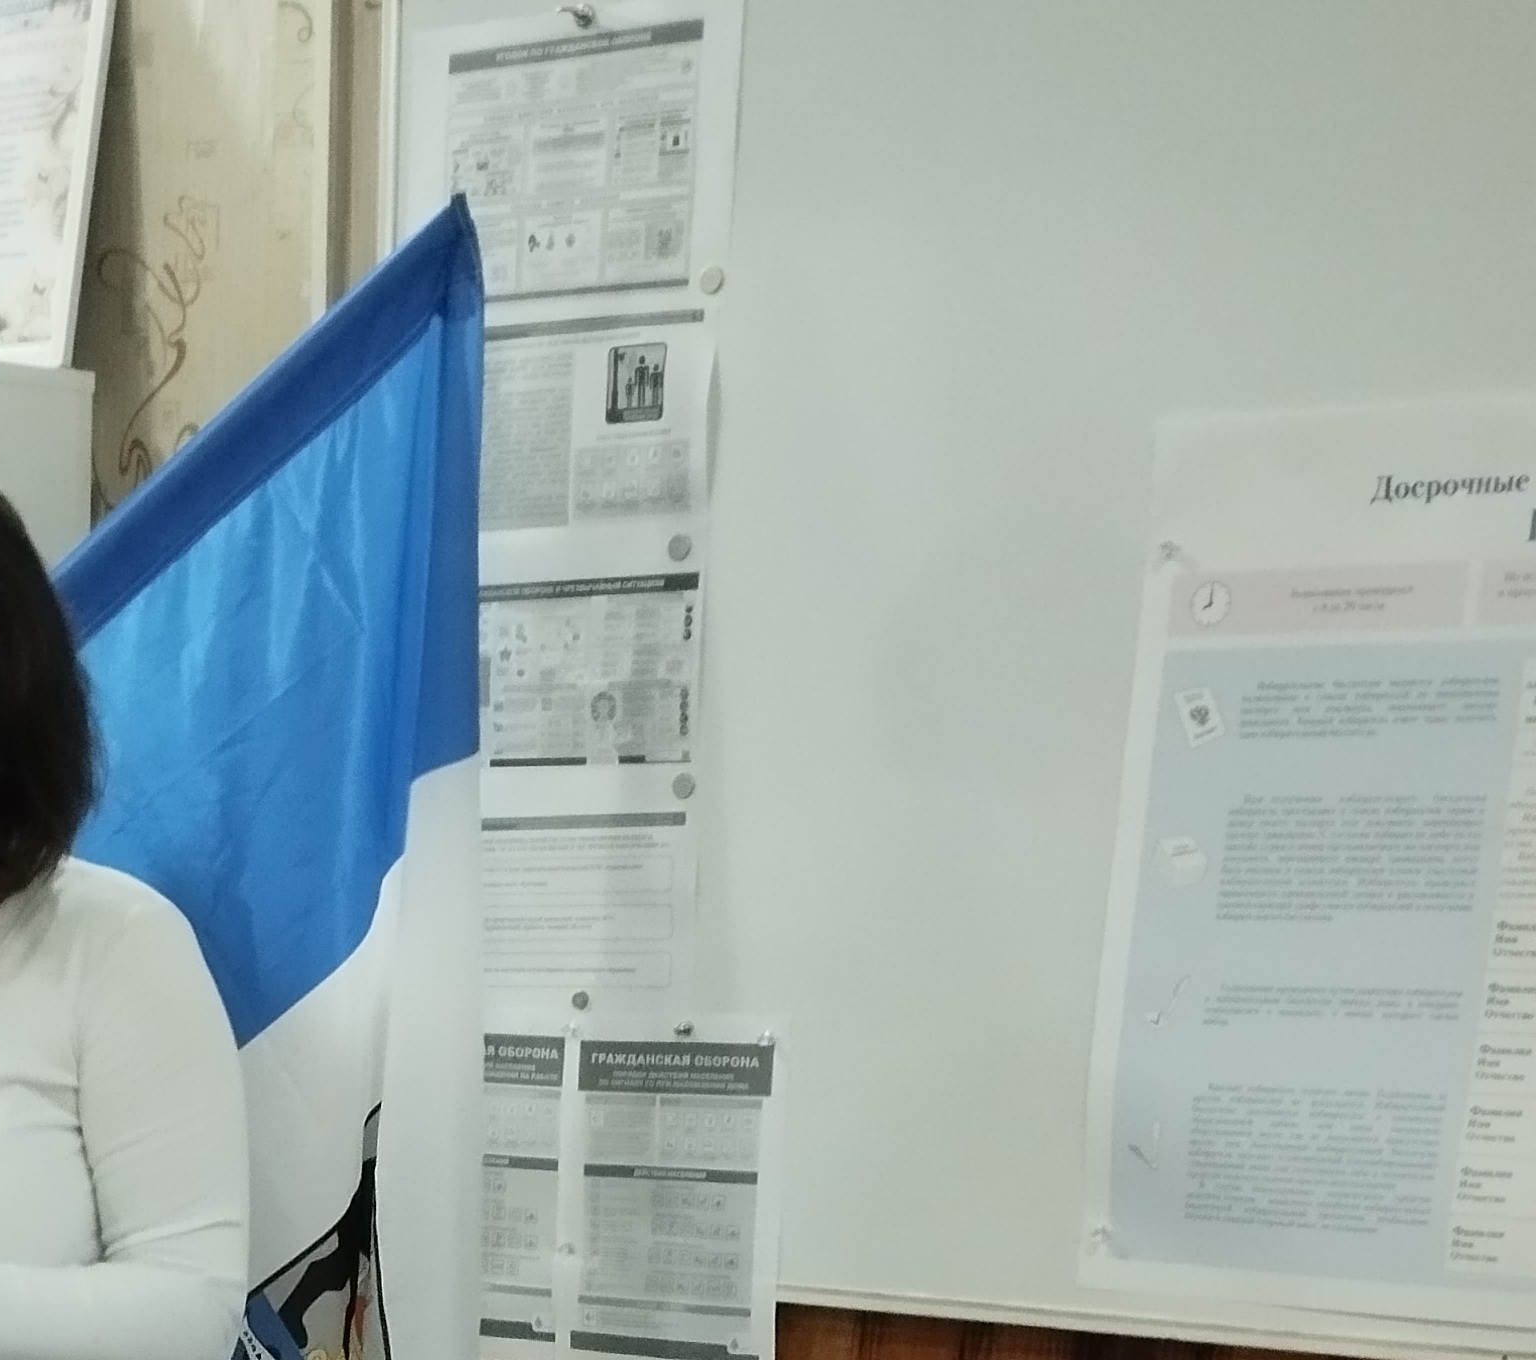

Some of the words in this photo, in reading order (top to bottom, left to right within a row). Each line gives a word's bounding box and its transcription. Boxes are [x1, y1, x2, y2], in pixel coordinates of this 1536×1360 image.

[1369, 474, 1530, 505] Досрочные
[498, 1045, 558, 1060] ОБОРОНА
[591, 1052, 691, 1067] ГРАЖДАНСКАЯ
[694, 1055, 760, 1068] ОБОРОНА
